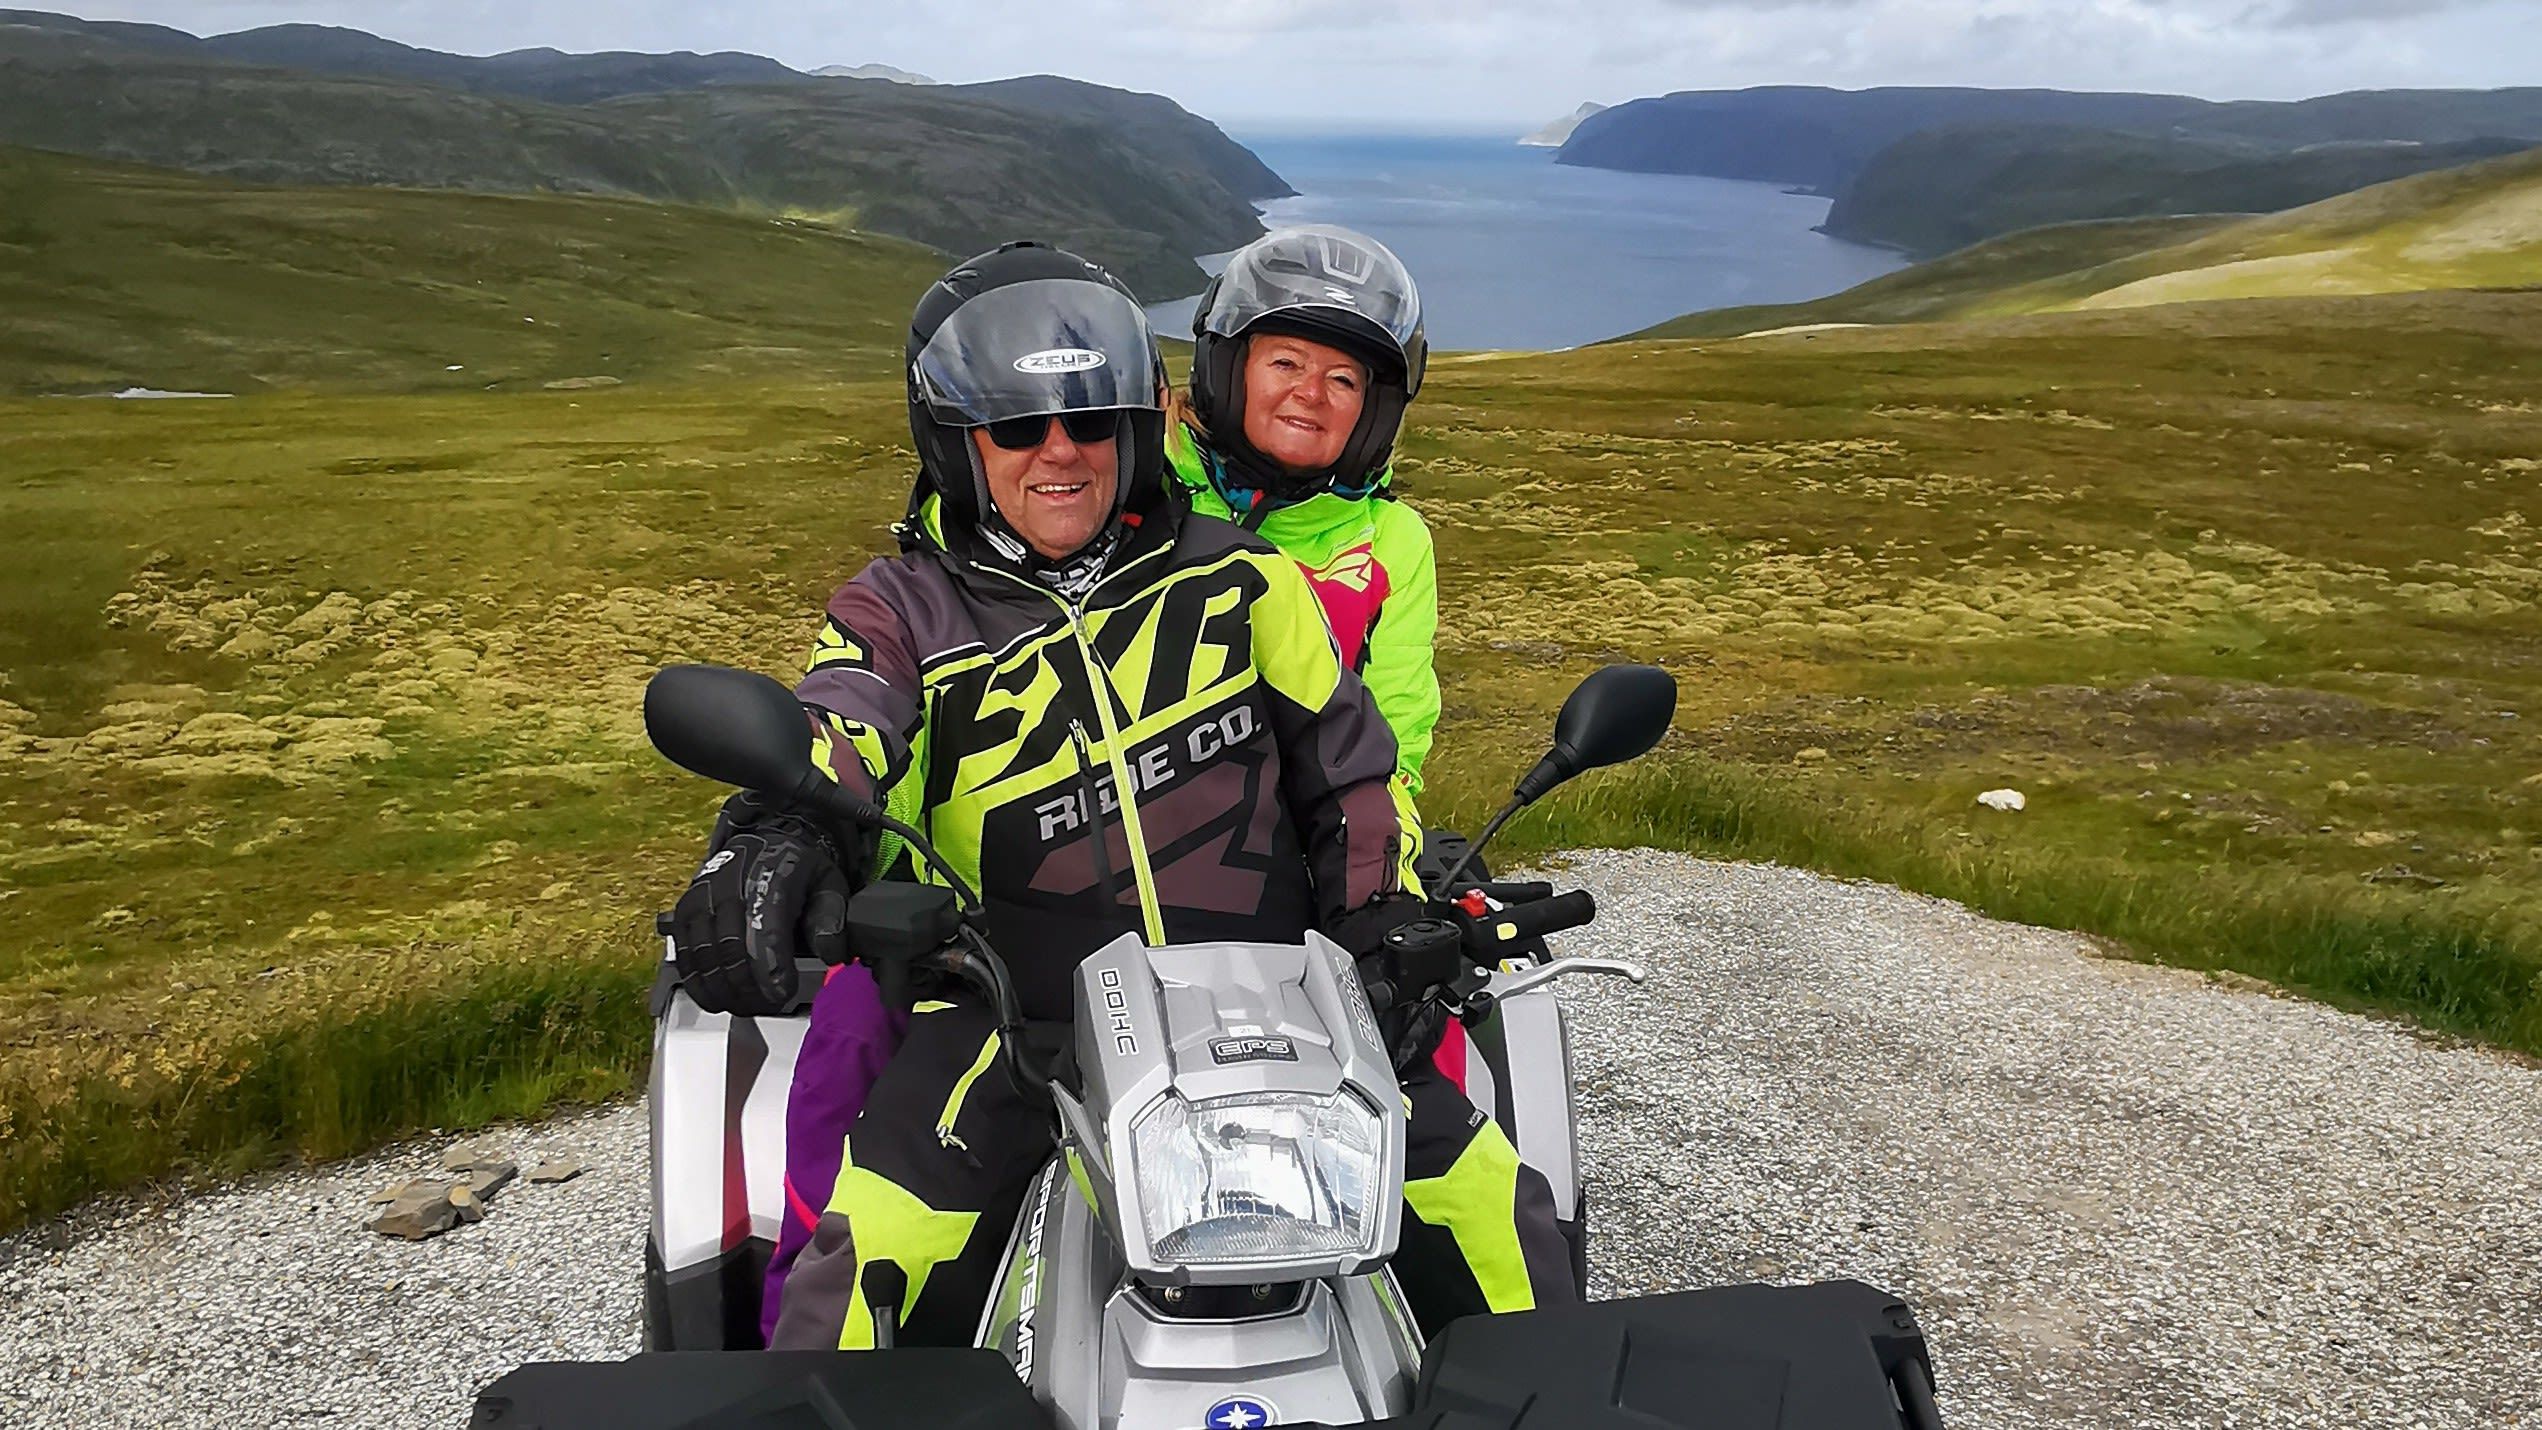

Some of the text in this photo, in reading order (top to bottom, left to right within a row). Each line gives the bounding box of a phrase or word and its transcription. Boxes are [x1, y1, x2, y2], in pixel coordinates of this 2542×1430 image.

[1029, 353, 1090, 367] ZEUS
[1033, 705, 1263, 841] RIDE CO.
[1098, 968, 1140, 1056] DOHC
[1215, 1040, 1290, 1056] EPS
